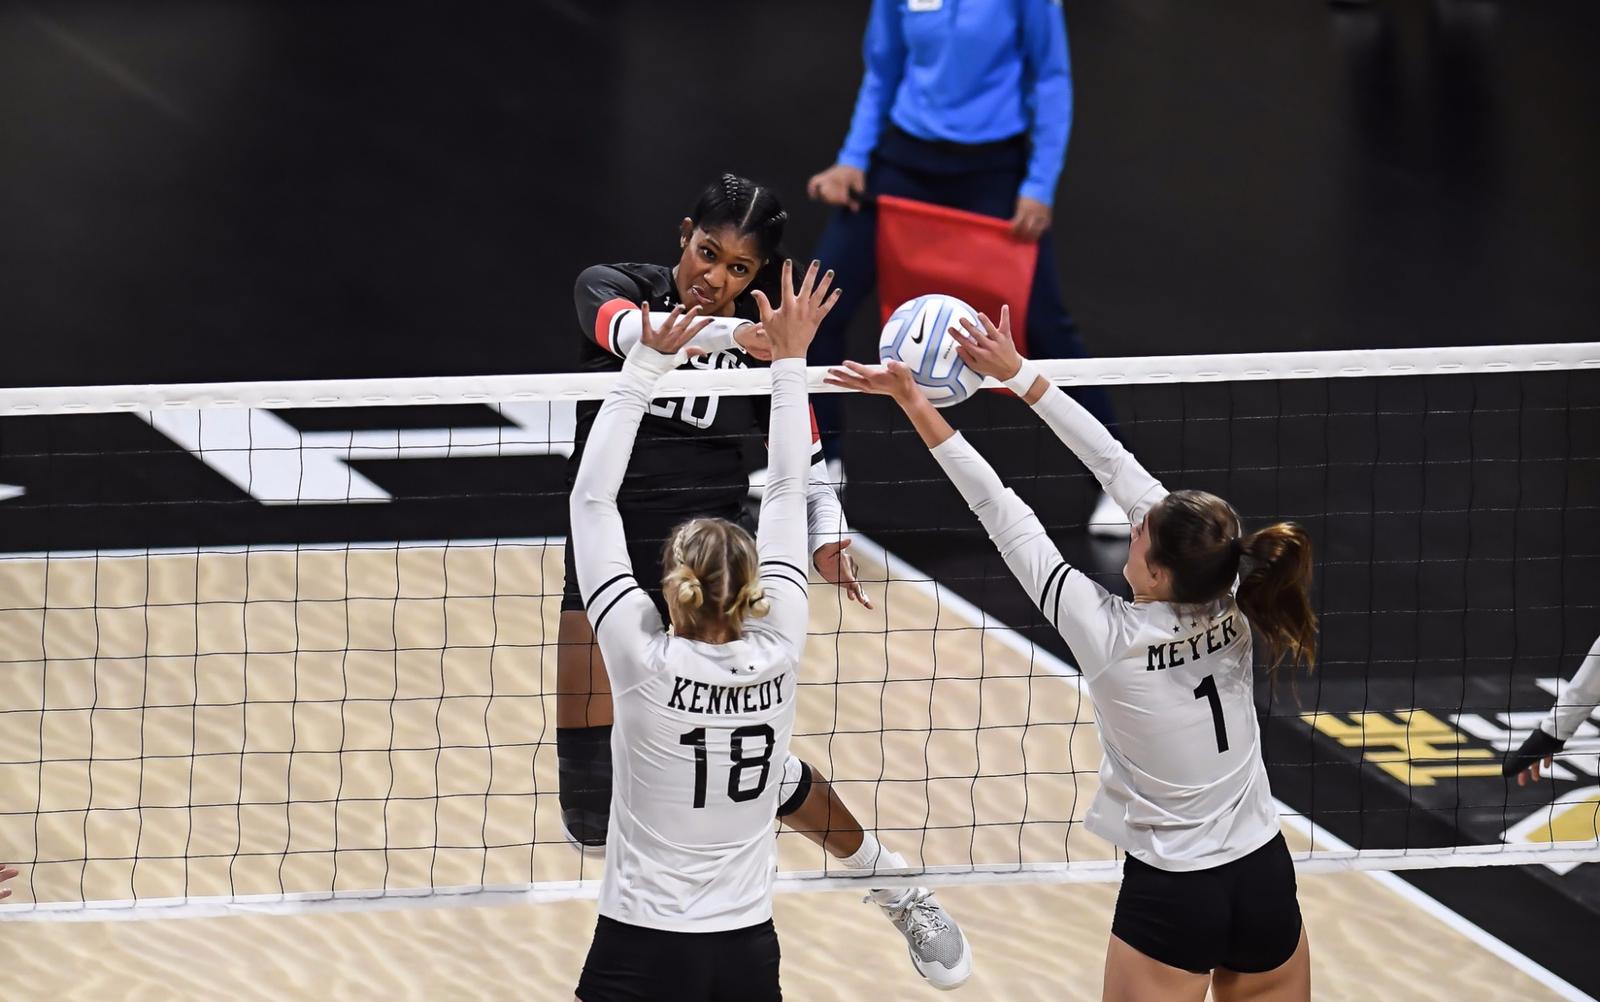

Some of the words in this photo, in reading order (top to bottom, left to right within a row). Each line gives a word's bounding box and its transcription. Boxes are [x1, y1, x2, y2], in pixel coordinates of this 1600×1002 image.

[1146, 615, 1237, 671] MEYER
[667, 672, 786, 714] KENNEDY
[1193, 674, 1229, 753] 1
[679, 723, 775, 808] 18
